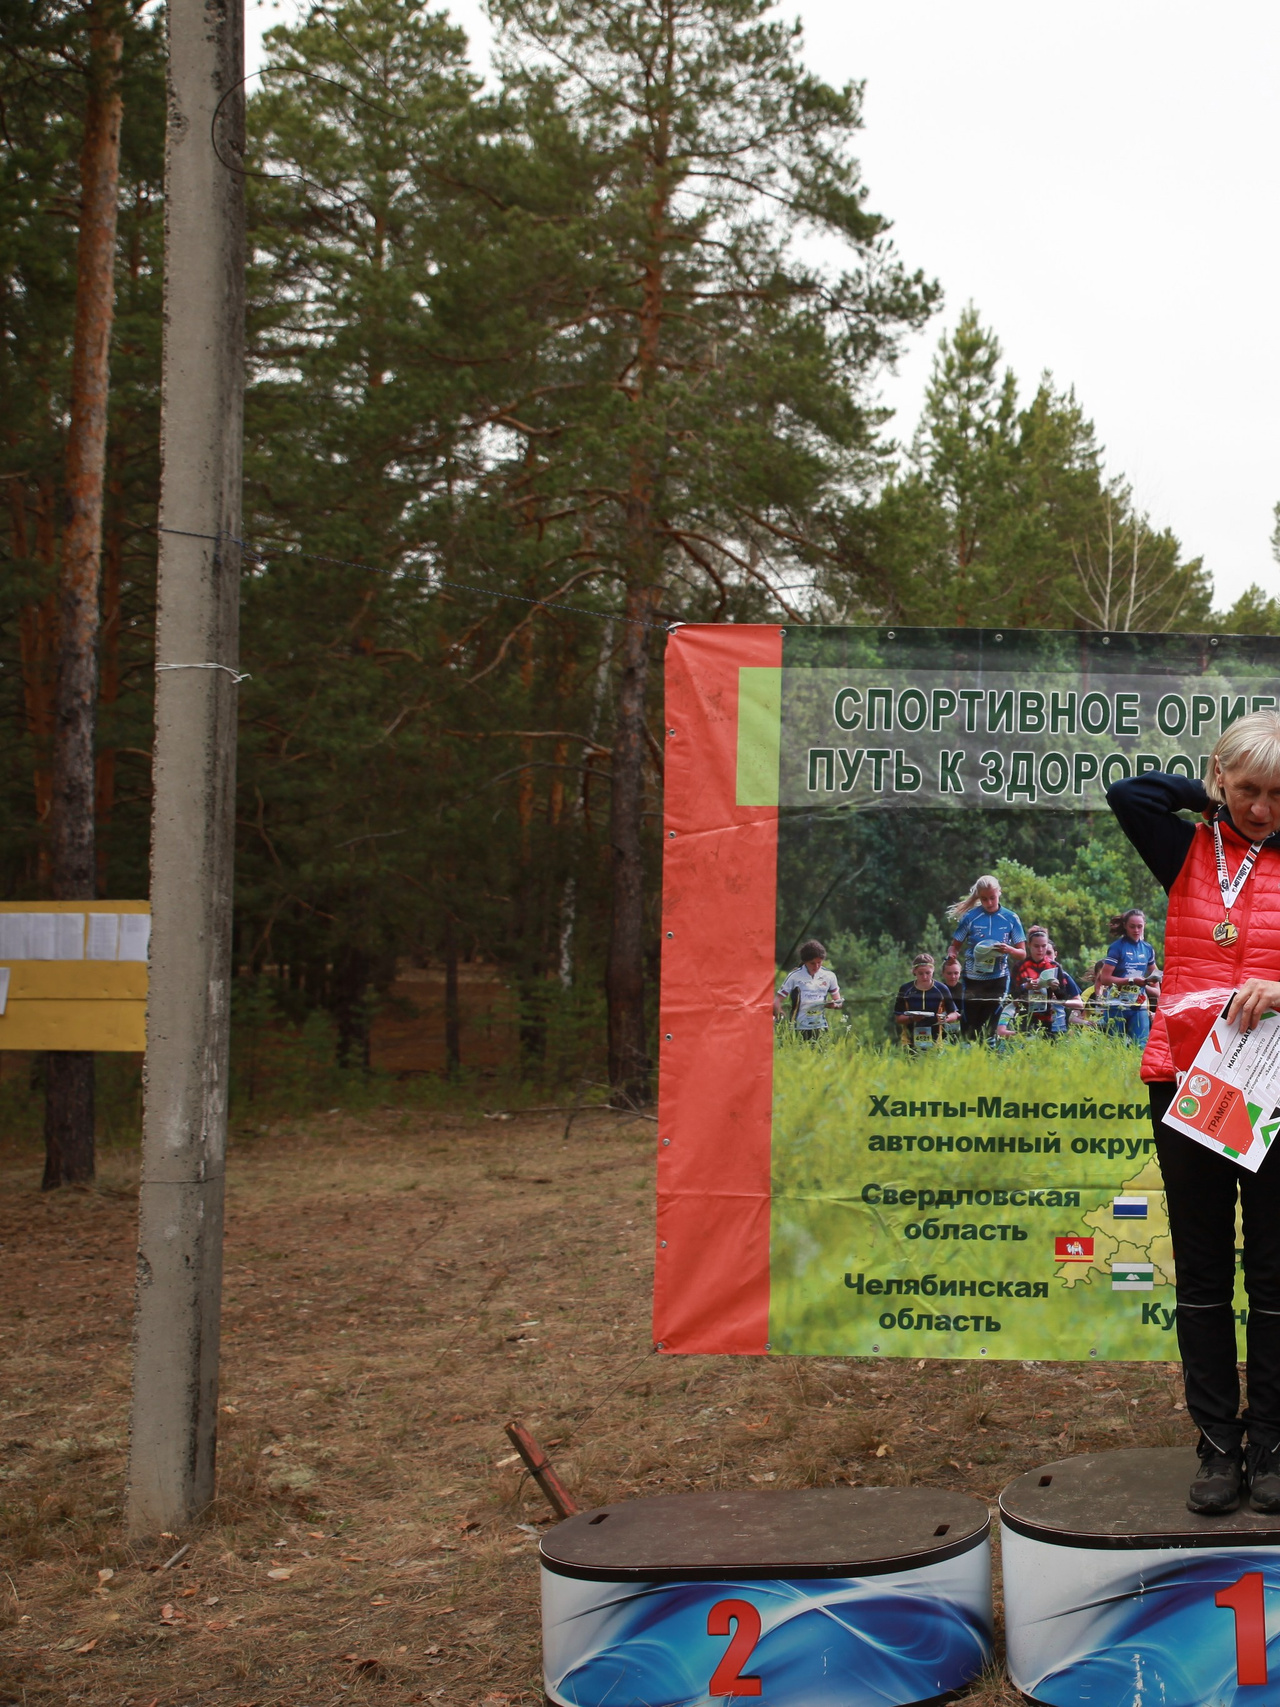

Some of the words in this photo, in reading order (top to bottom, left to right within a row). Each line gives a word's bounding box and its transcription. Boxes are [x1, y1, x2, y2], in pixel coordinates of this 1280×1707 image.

[834, 686, 1141, 736] СПОРТИВНОЕ
[807, 748, 922, 793] ПУТЬ
[939, 749, 965, 794] К
[868, 1095, 1152, 1120] Ханты-Мансийски
[1208, 1090, 1235, 1132] ГРАМОТА
[867, 1131, 1061, 1154] автономный
[1071, 1137, 1156, 1160] округ
[860, 1183, 1081, 1210] Свердловская
[904, 1217, 1028, 1242] область
[843, 1272, 1049, 1299] Челябинская
[878, 1306, 1002, 1333] область
[1214, 1572, 1268, 1685] 1
[707, 1599, 762, 1696] 2
